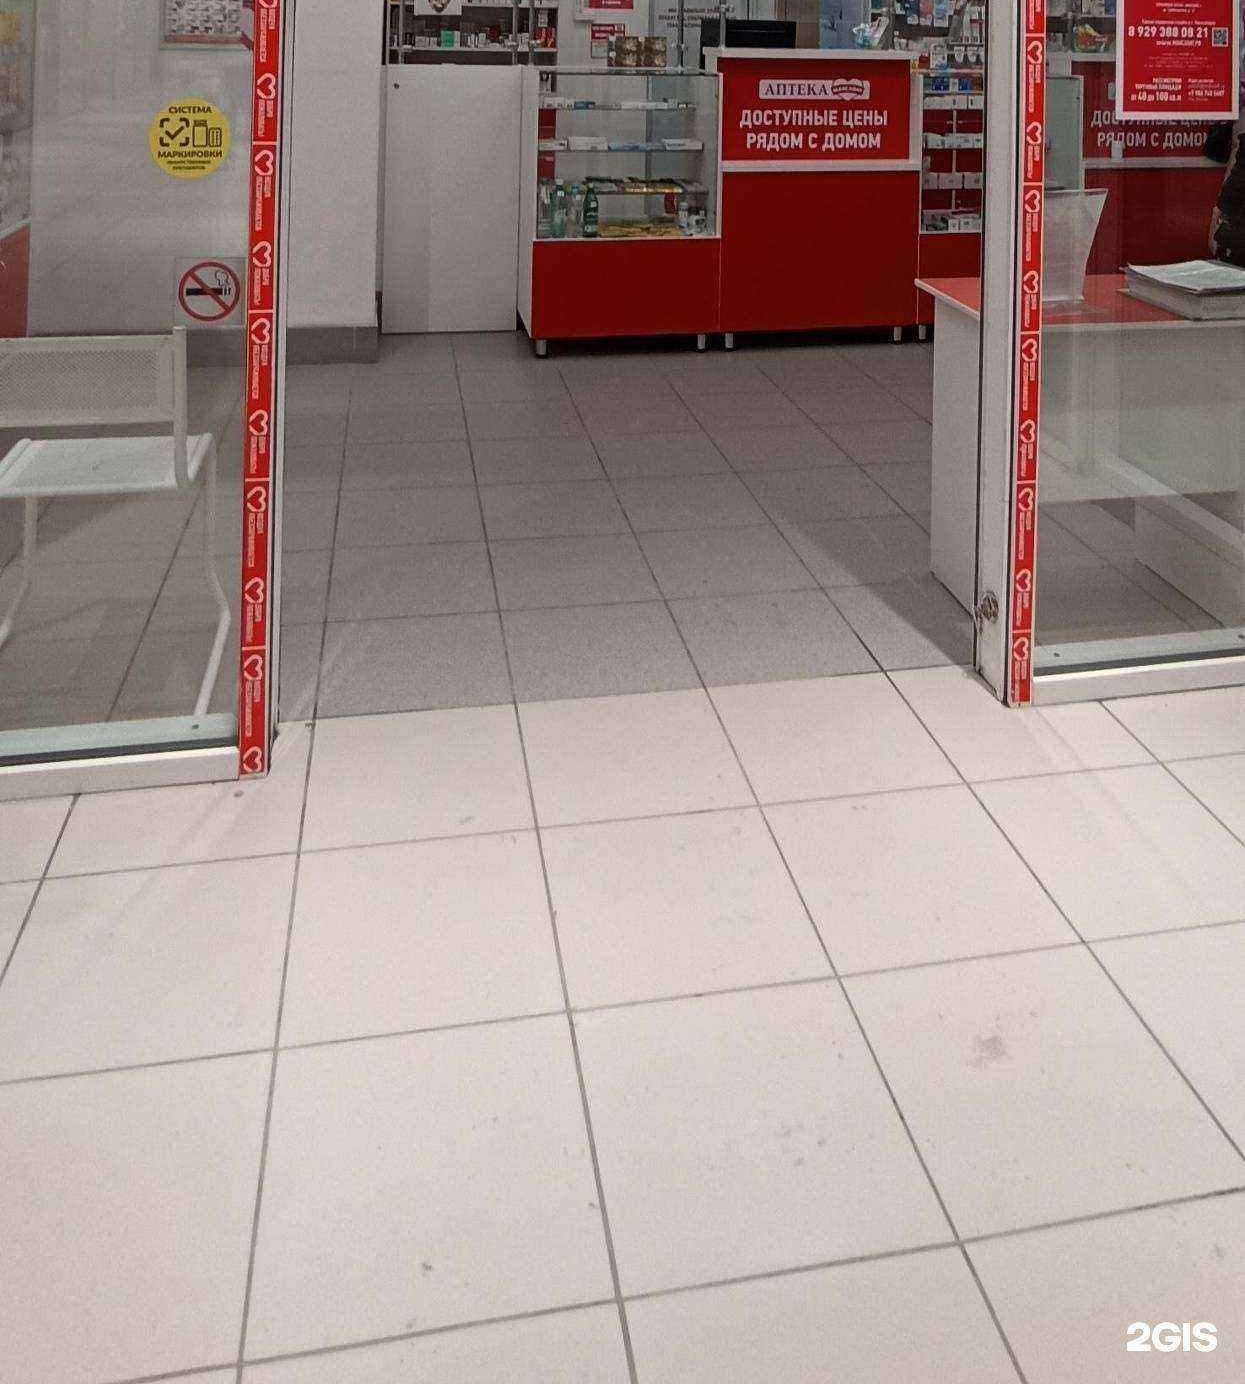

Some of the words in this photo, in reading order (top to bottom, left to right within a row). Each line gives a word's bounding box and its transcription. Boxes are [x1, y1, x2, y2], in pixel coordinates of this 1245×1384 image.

[1128, 25, 1135, 37] 8
[1137, 25, 1157, 38] 929
[1196, 26, 1208, 38] 21
[764, 83, 829, 96] АПТЕКА
[1156, 91, 1169, 102] 100
[168, 106, 213, 114] СИСТЕМА
[739, 109, 839, 129] ДОСТУПНЫЕ
[842, 110, 888, 129] ЦЕНЫ
[746, 132, 803, 152] РЯДОМ
[808, 132, 818, 149] С
[822, 132, 881, 152] ДОМОМ
[1150, 132, 1160, 147] С
[157, 149, 223, 159] МАРКИРОВКИ
